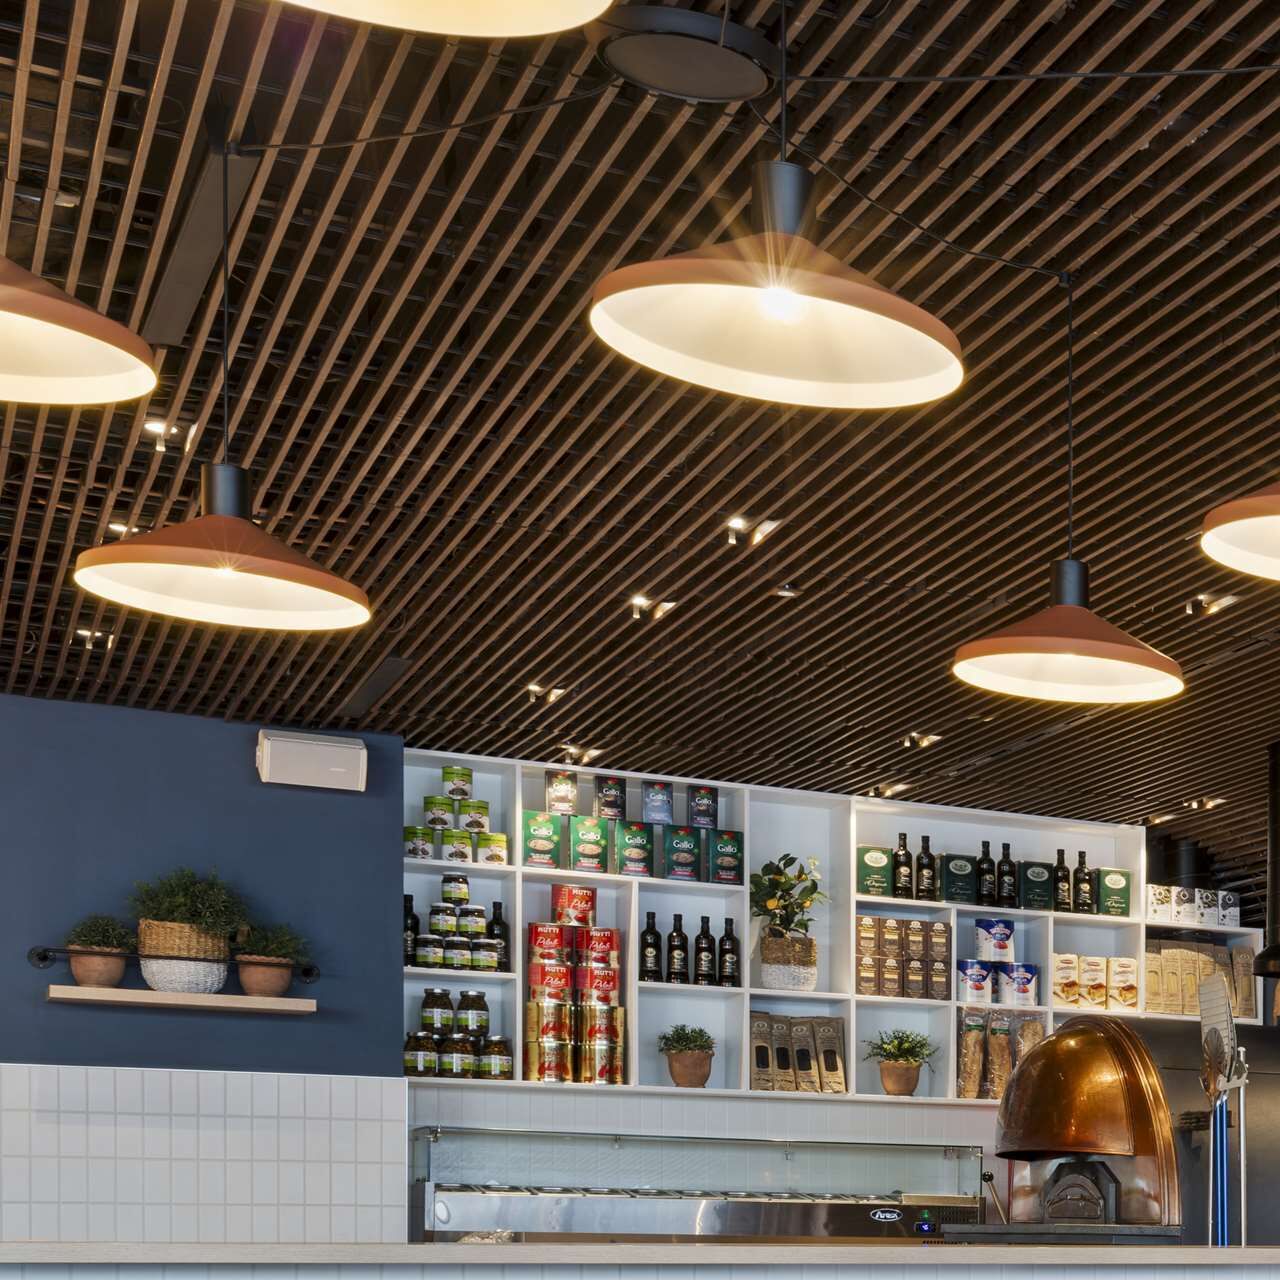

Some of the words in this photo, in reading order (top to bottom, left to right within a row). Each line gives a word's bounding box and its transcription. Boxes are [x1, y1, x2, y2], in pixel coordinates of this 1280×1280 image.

[695, 797, 712, 806] Gallo
[625, 835, 647, 845] Gallo
[672, 840, 694, 849] Gallo
[717, 844, 737, 853] Gallo
[572, 888, 592, 897] MUTTI
[545, 966, 566, 974] MUTTI
[593, 969, 614, 977] MUTTI
